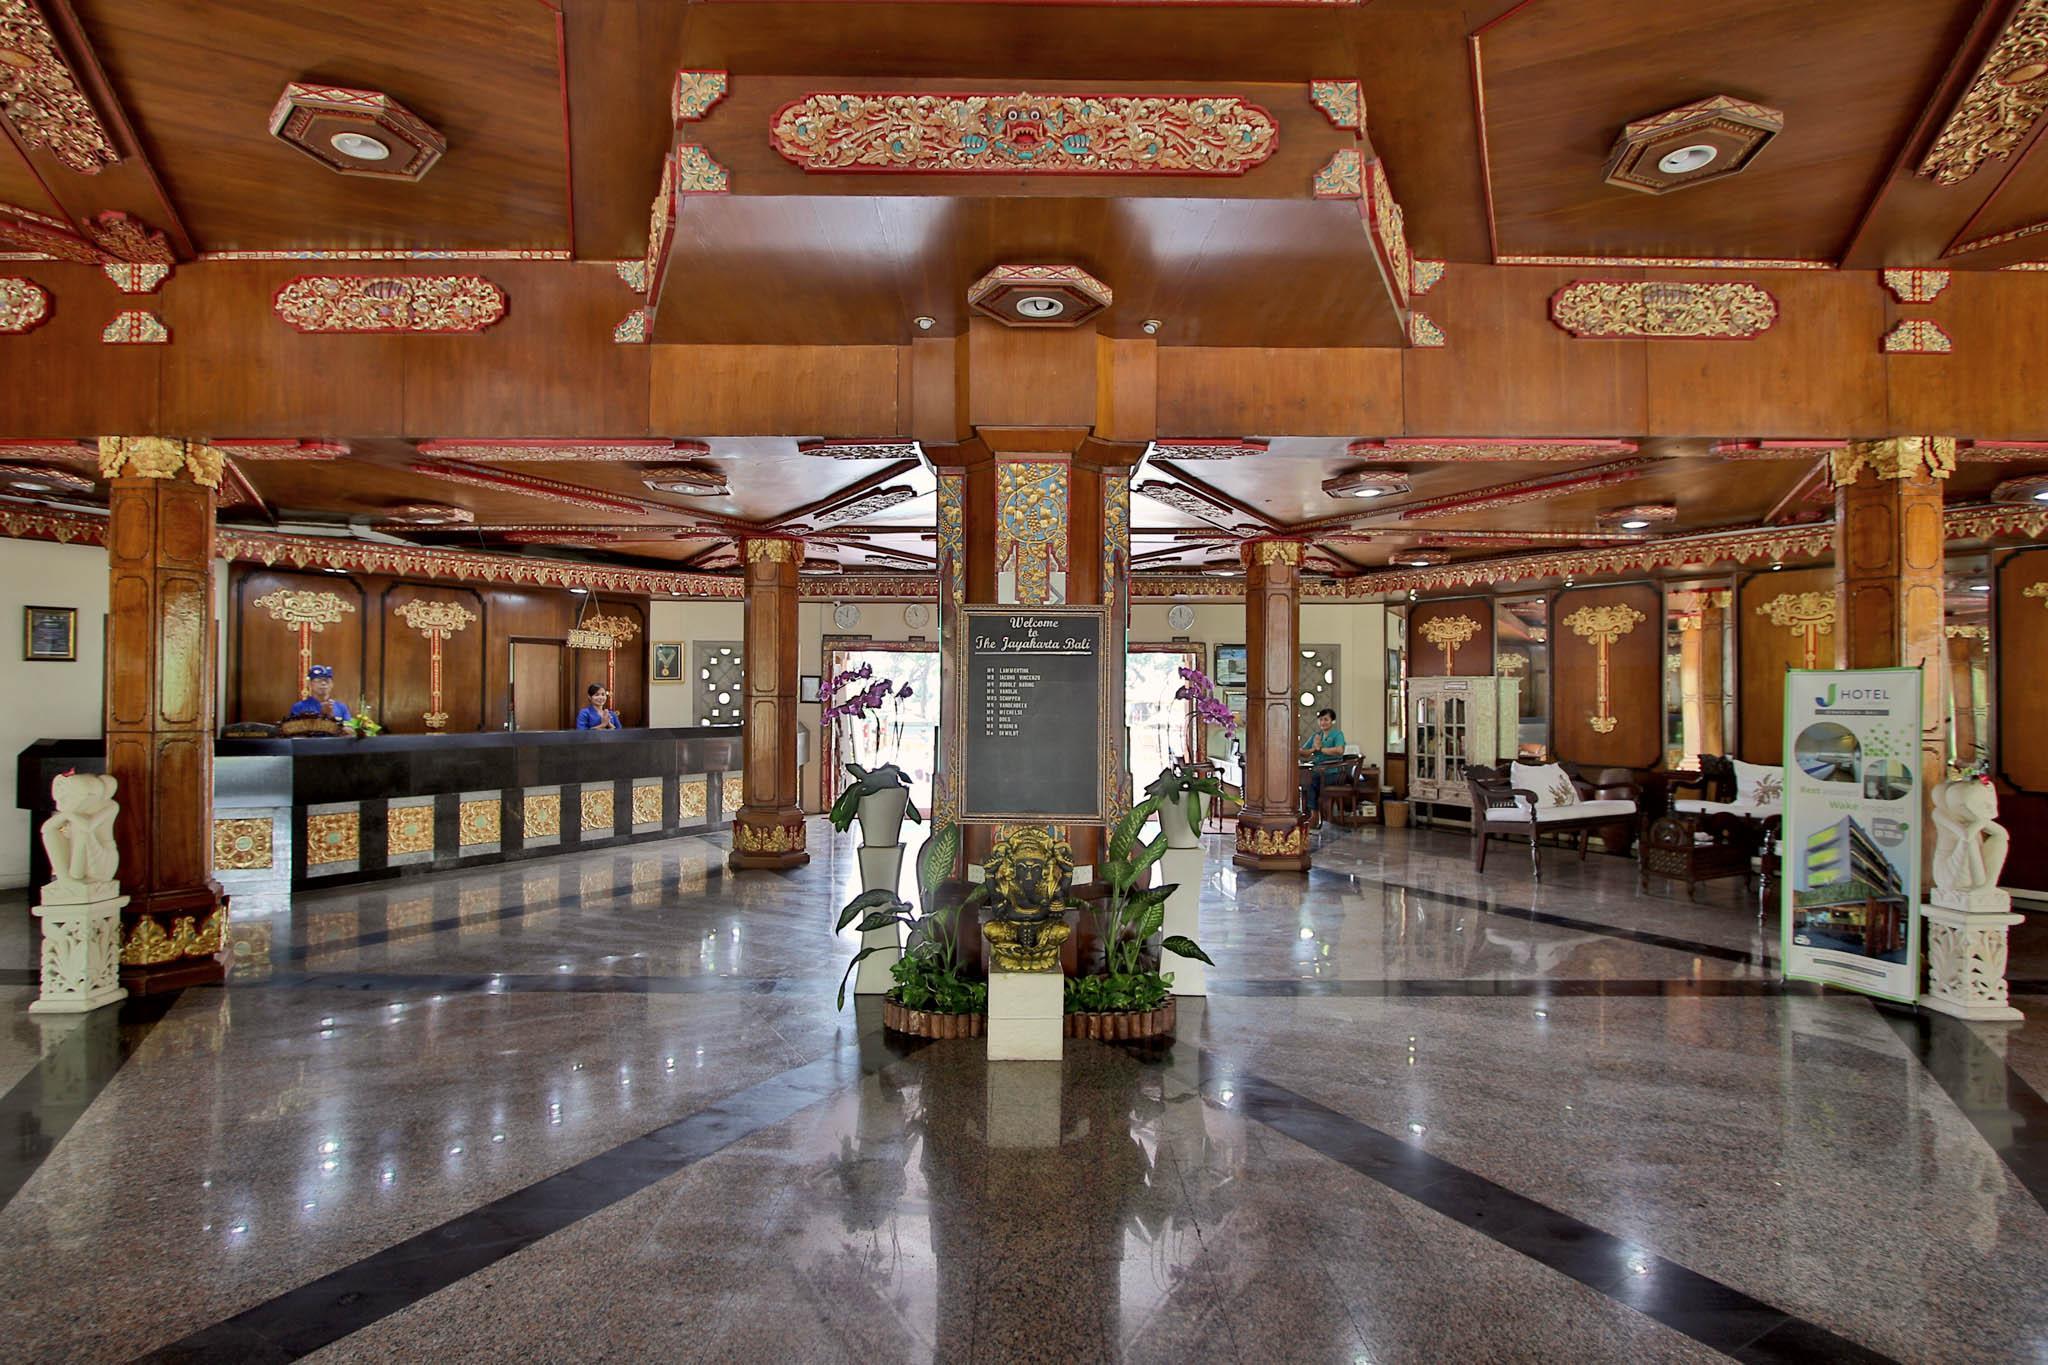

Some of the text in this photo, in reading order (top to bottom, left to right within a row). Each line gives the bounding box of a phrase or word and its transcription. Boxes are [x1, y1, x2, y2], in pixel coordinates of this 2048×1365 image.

[1009, 616, 1059, 628] Welcome
[1027, 628, 1039, 637] to
[975, 636, 1091, 652] The Jayakarta Bali
[1840, 689, 1890, 700] HOTEL
